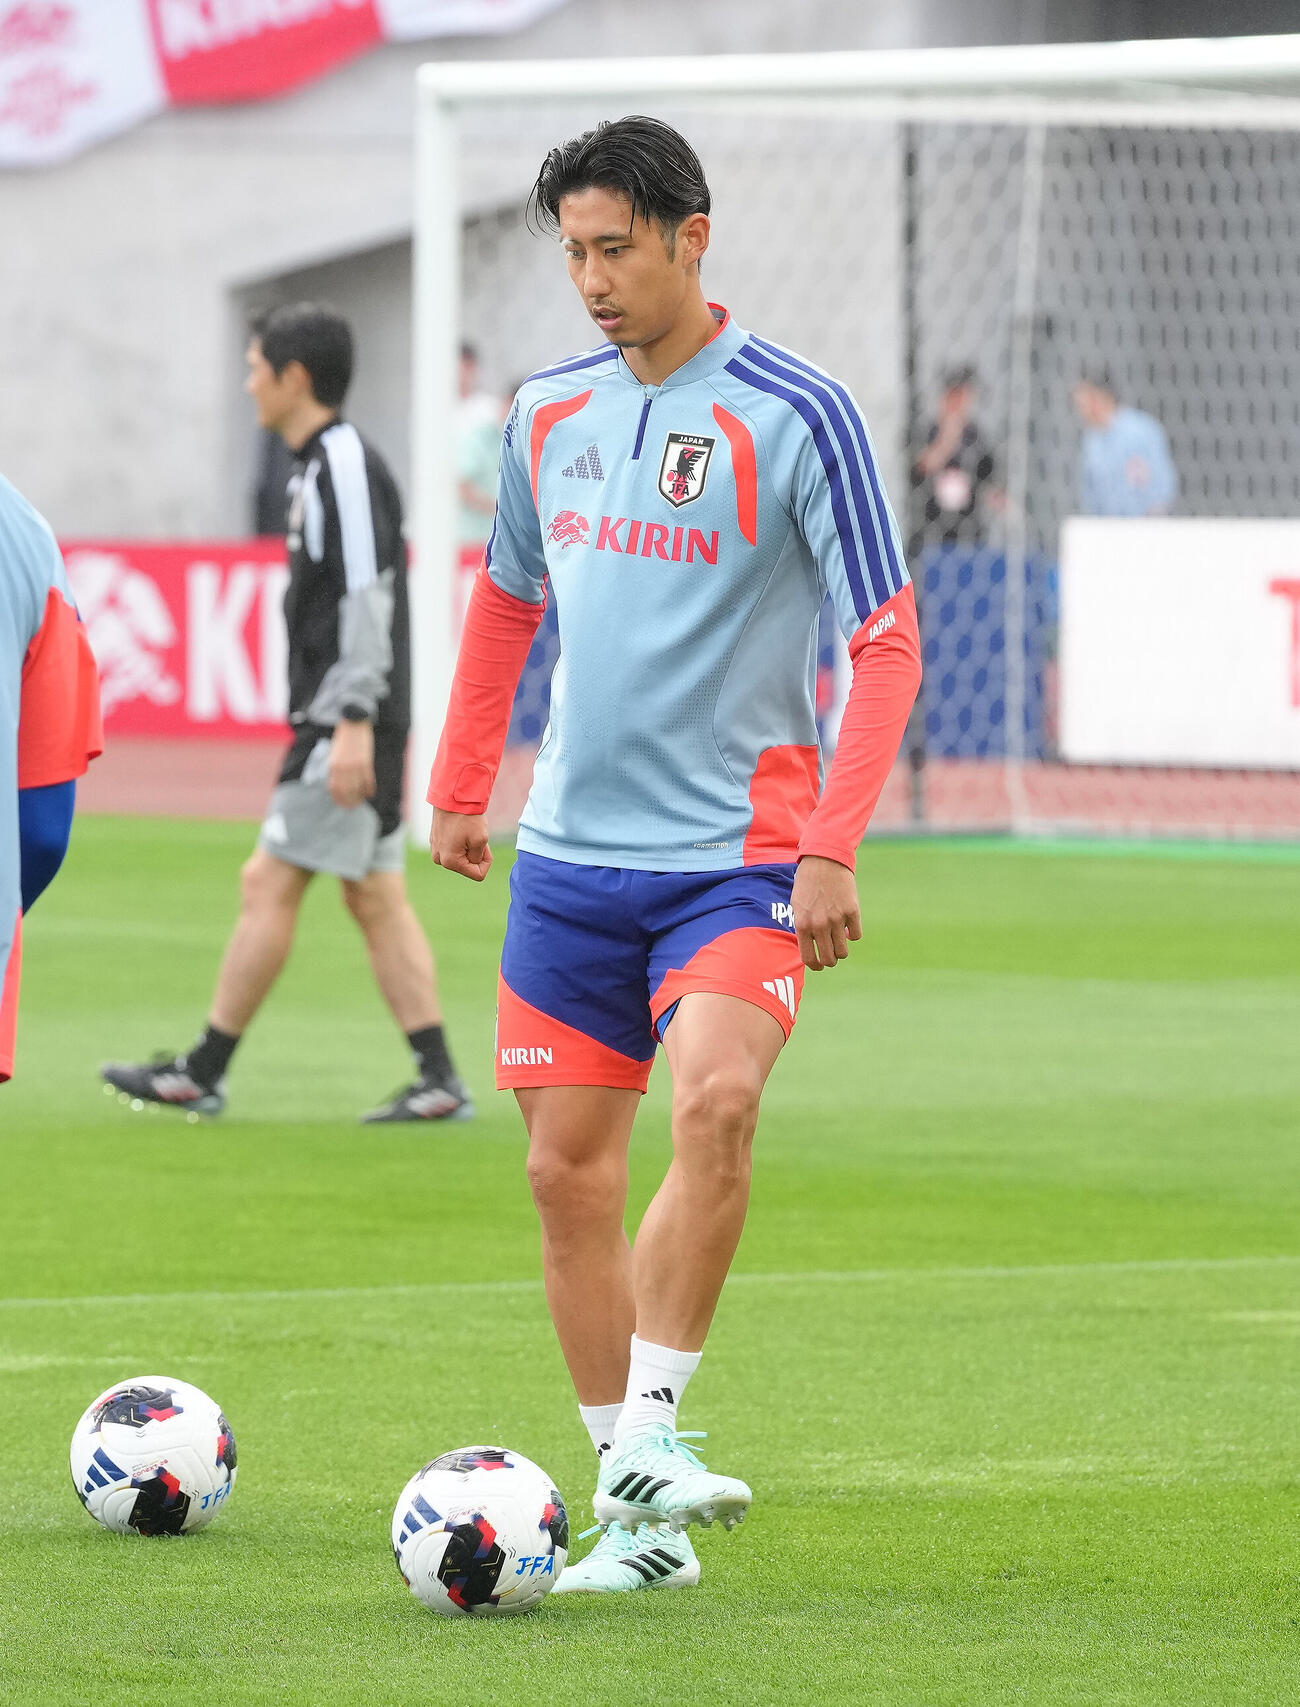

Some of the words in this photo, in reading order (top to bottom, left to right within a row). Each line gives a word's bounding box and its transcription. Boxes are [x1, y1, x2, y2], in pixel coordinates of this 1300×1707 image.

[678, 436, 704, 445] JAPAN
[668, 483, 690, 496] JFA
[595, 515, 720, 565] KIRIN
[869, 609, 897, 643] JAPAN
[501, 1047, 554, 1066] KIRIN
[515, 1555, 555, 1577] JFA
